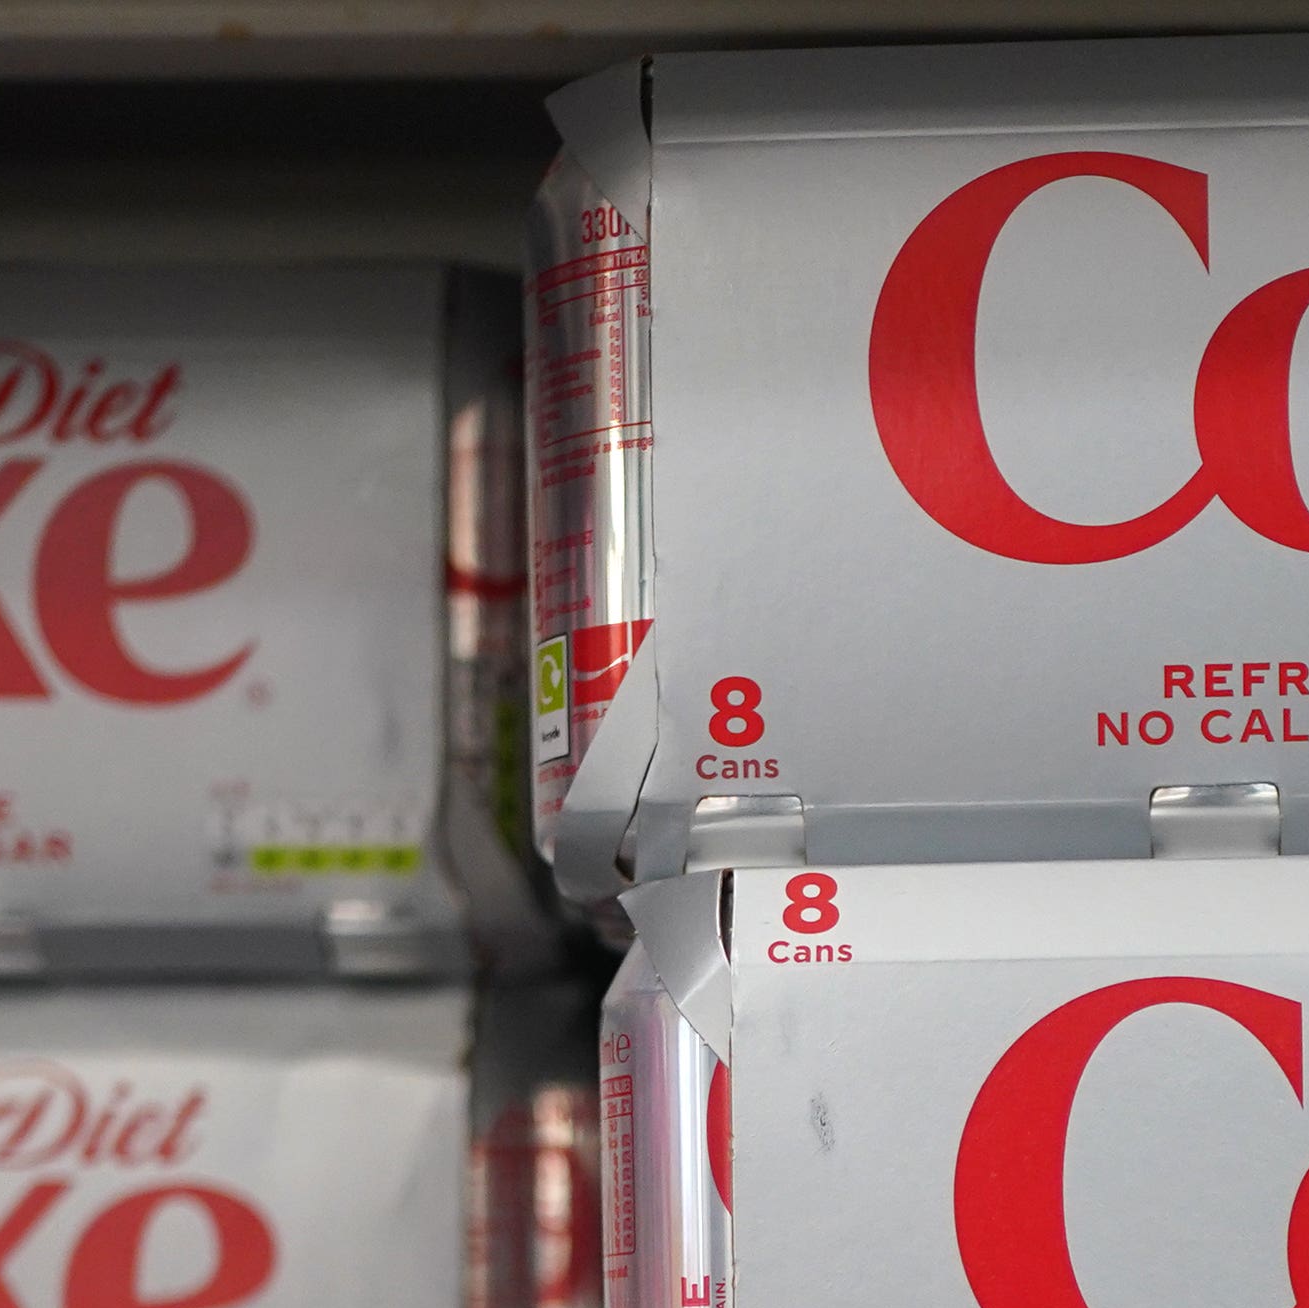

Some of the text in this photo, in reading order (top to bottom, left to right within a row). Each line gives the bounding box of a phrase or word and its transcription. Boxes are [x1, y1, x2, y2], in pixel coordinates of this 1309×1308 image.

[582, 206, 633, 243] 330
[709, 676, 765, 748] 8
[1097, 711, 1175, 746] NO
[695, 753, 779, 781] Cans
[783, 872, 840, 935] 8
[767, 939, 853, 965] Cans
